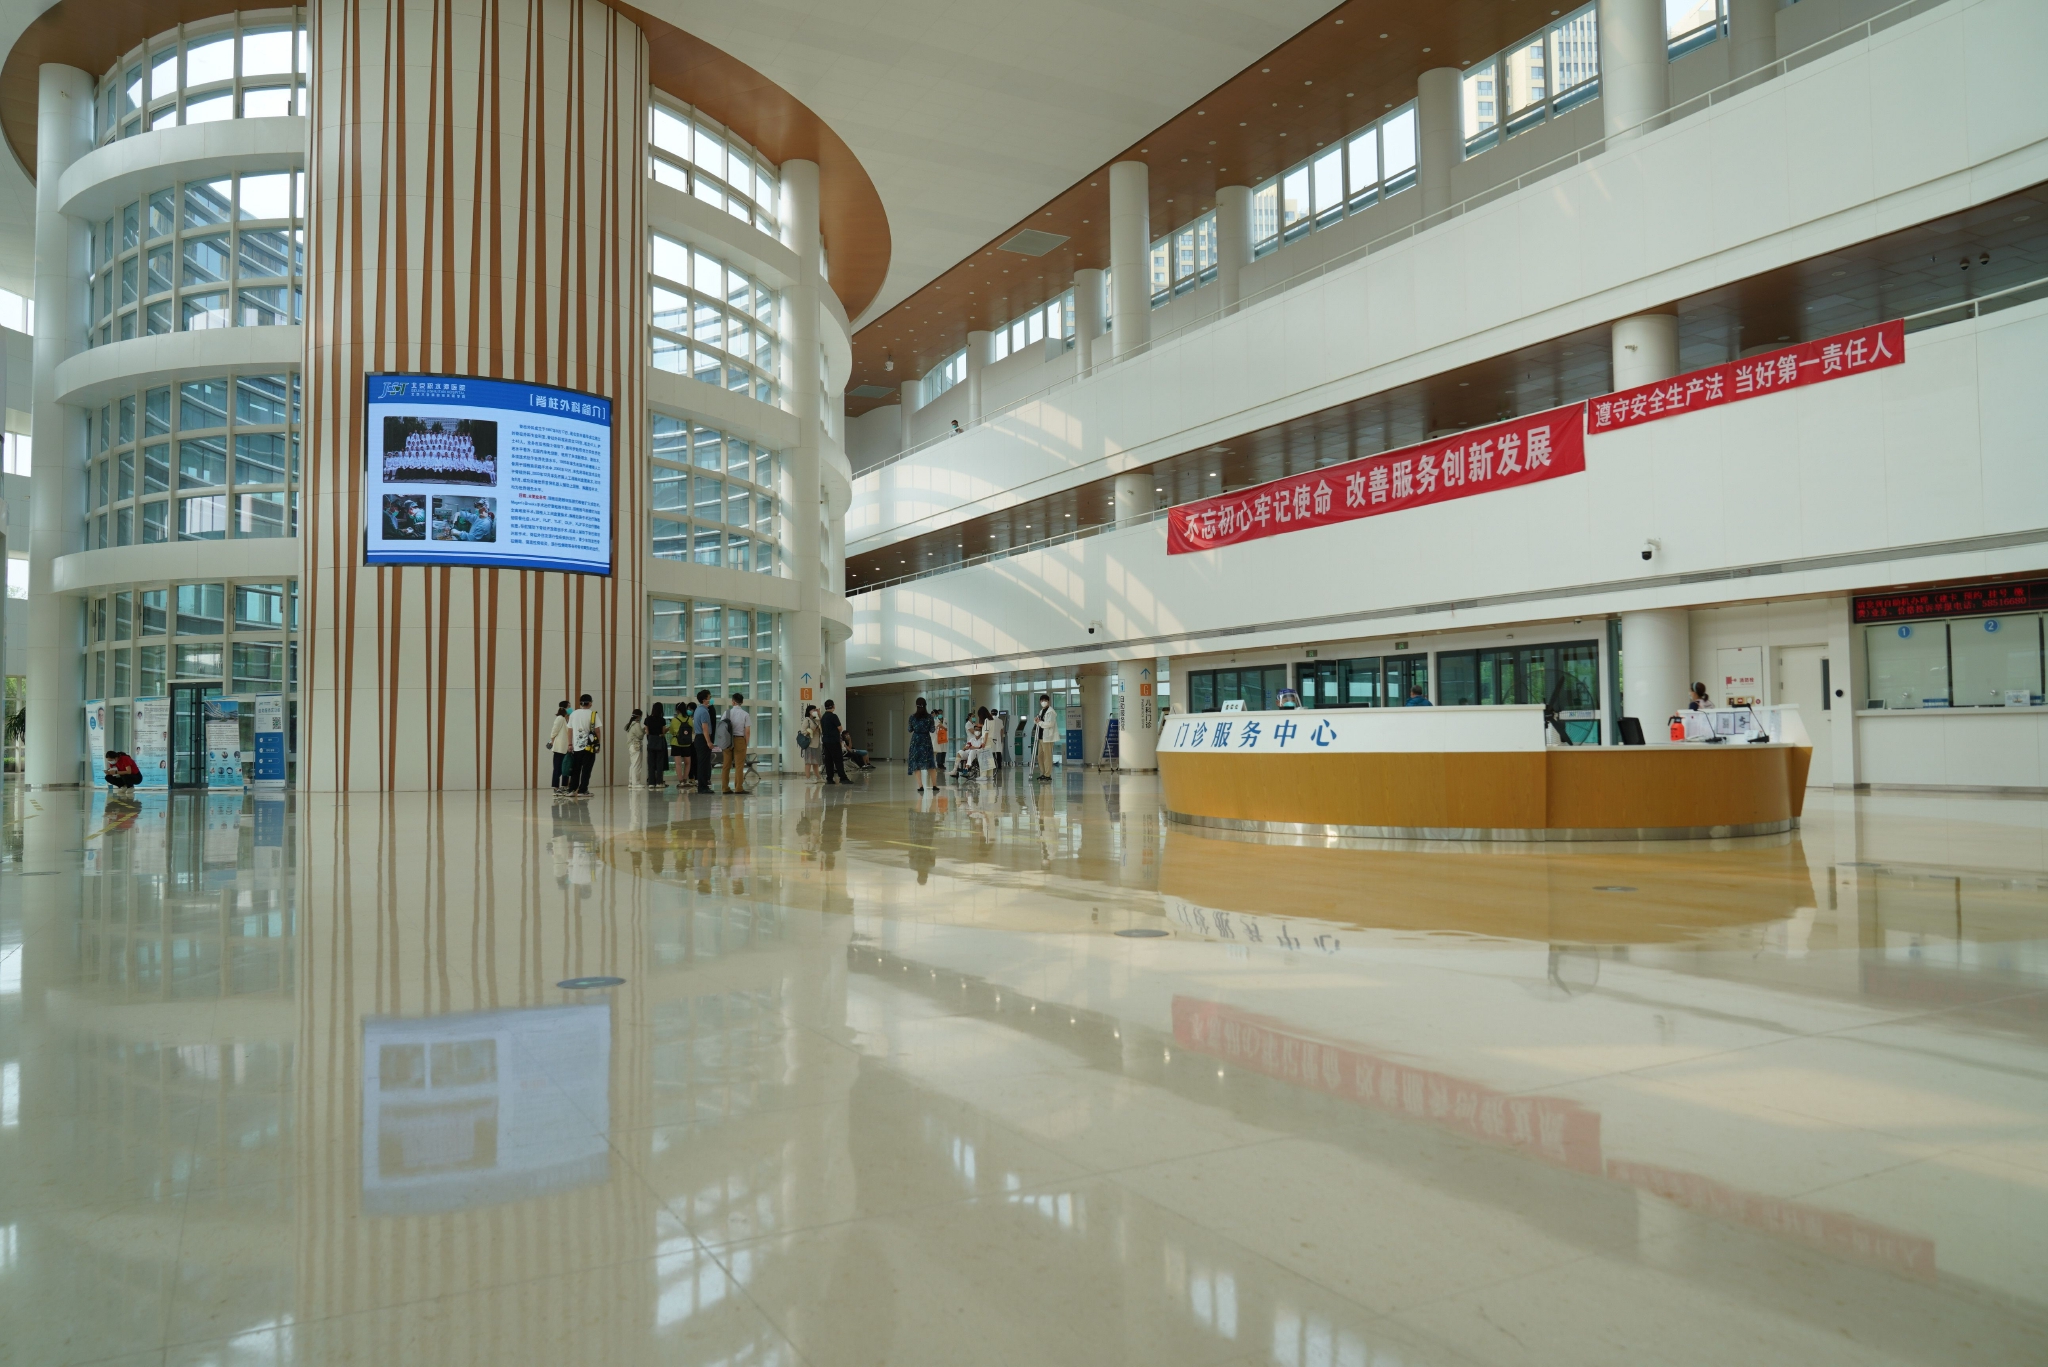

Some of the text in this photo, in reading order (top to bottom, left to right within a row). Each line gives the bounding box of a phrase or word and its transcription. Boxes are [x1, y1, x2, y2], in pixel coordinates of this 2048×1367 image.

[1595, 328, 1893, 427] 遵守安全生产法 当好第一责任人
[1183, 425, 1552, 544] 不忘初心牢记使命 改善服务创新发展
[1174, 719, 1338, 748] 门诊服务中心
